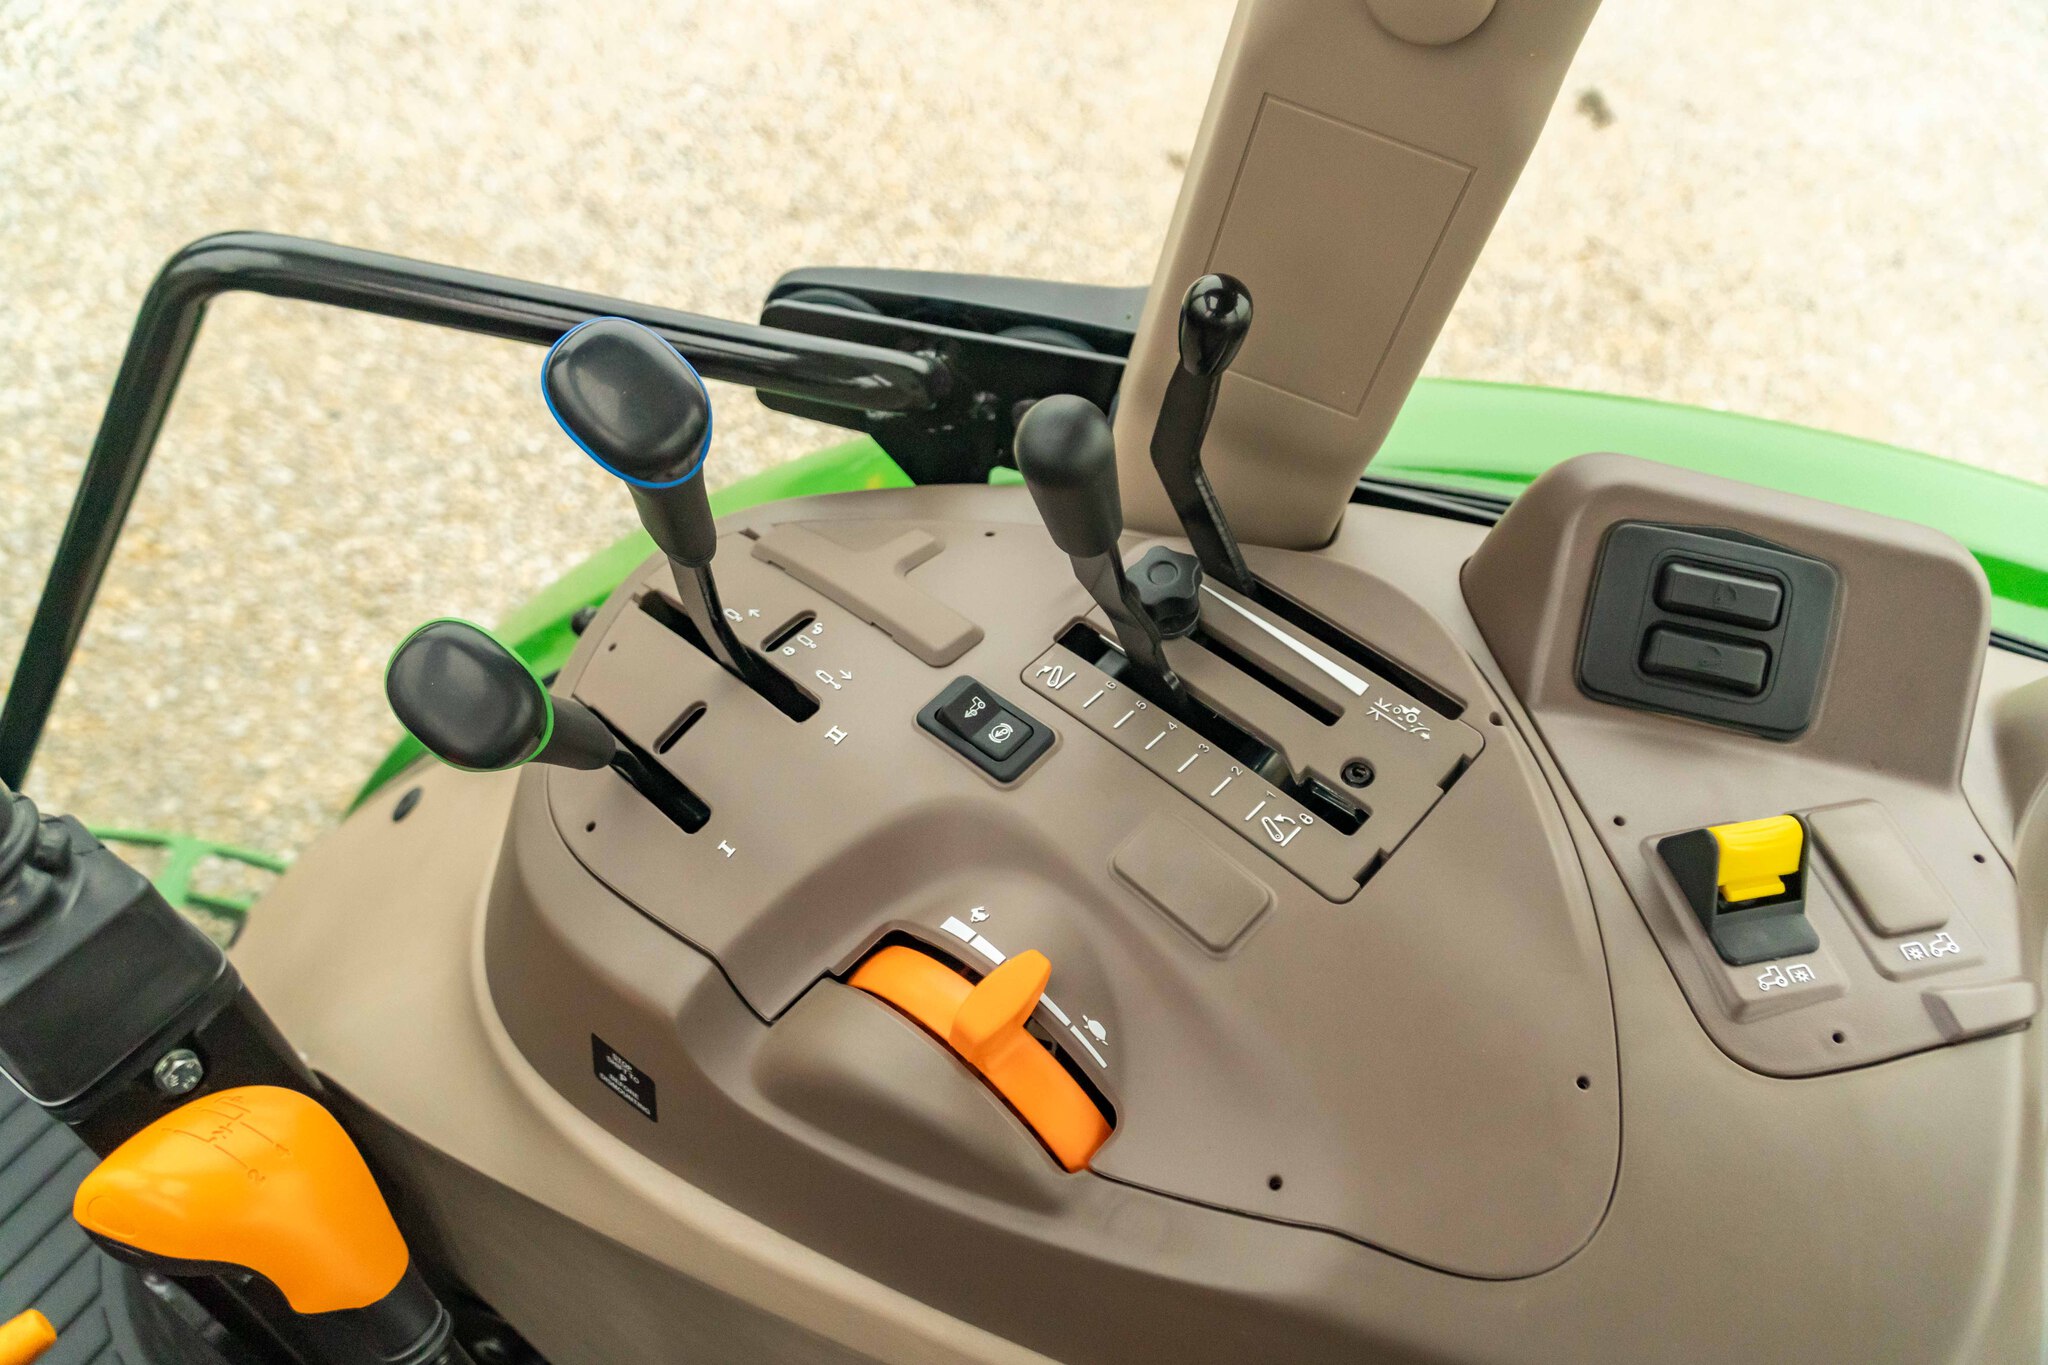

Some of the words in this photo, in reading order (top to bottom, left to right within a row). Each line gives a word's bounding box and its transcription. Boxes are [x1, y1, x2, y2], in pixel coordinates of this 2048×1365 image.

[1105, 680, 1117, 690] 6
[1135, 700, 1147, 710] 5
[1168, 721, 1178, 730] 4
[1198, 743, 1210, 753] 3
[1231, 765, 1244, 776] 2
[1266, 790, 1277, 798] 1
